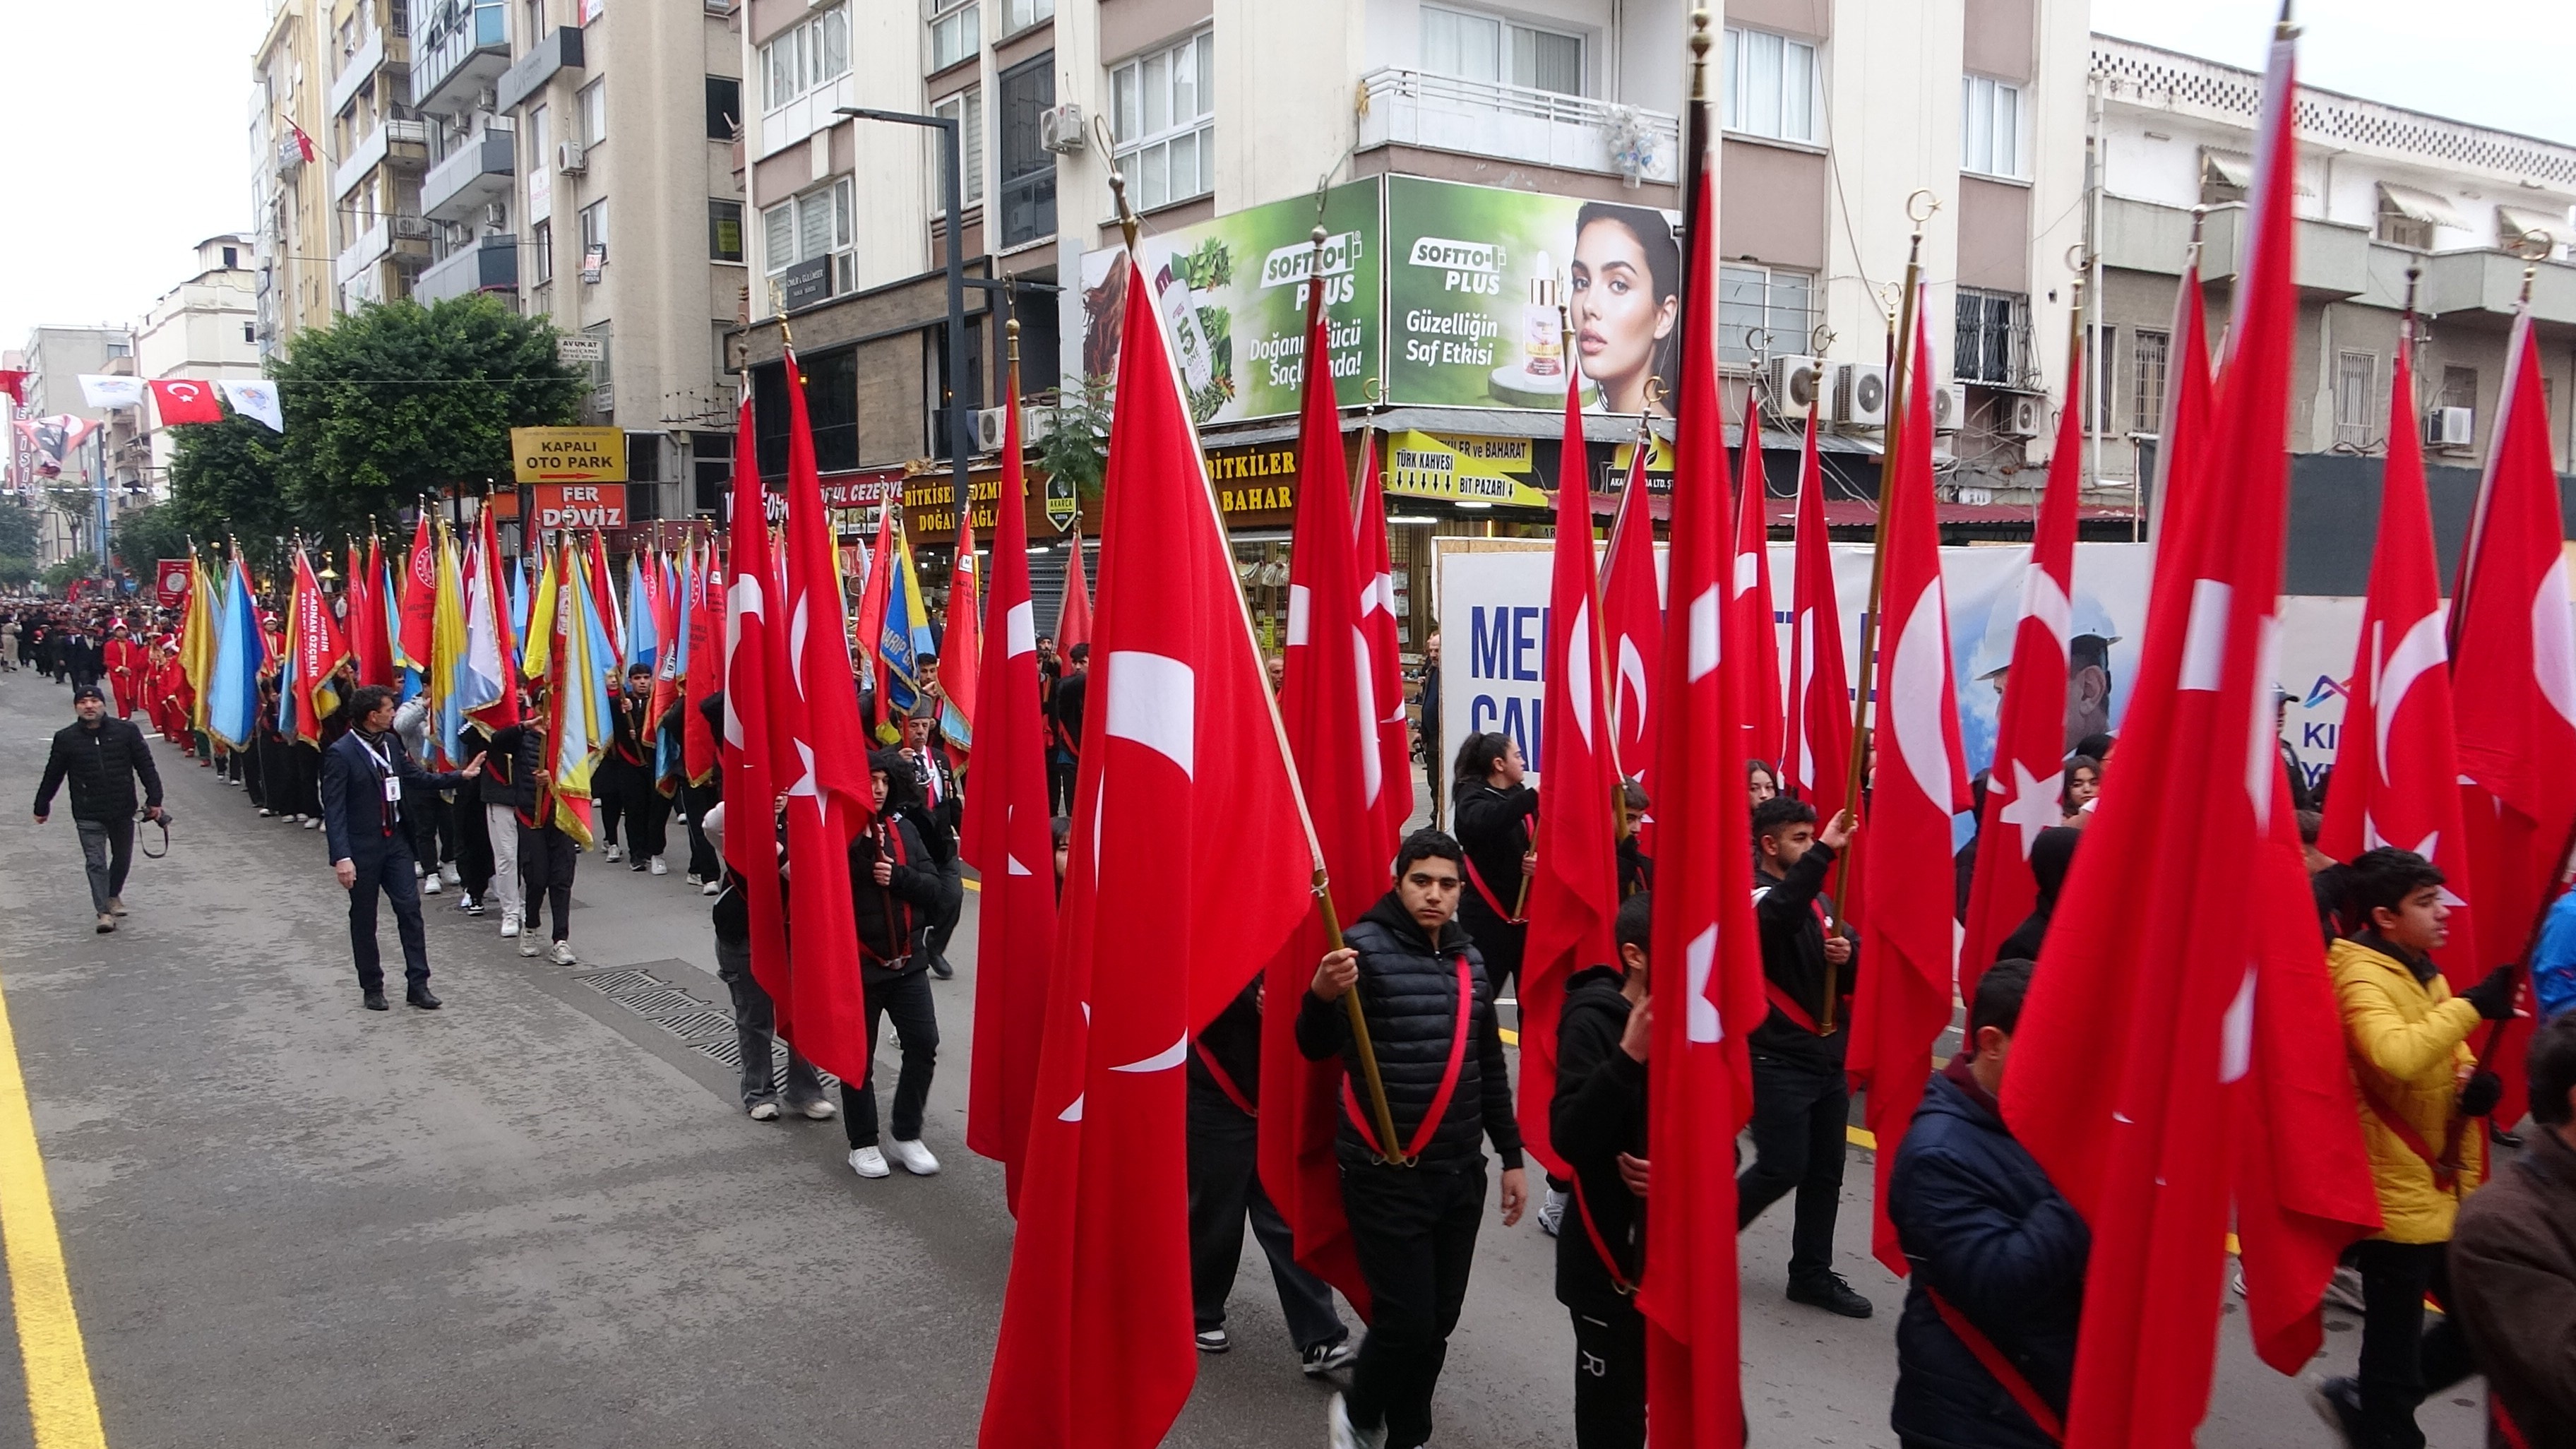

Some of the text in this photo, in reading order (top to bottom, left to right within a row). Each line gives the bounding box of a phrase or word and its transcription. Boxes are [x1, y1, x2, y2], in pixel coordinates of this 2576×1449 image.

[1268, 246, 1337, 281] SOFTO
[1417, 244, 1484, 267] SOFTTO
[1295, 274, 1355, 311] PUS
[1445, 270, 1501, 296] PLUS
[1406, 309, 1498, 342] Güzelliğin
[1249, 331, 1305, 364] Doğanı
[1406, 339, 1441, 367] Saf
[1442, 342, 1494, 366] Etkisi
[541, 441, 597, 453] KAPALI
[1473, 445, 1483, 458] ve
[1485, 441, 1527, 459] BAHARAT
[526, 456, 614, 469] OTO PARK
[1206, 447, 1296, 480] BİTKİLER
[1396, 449, 1454, 471] TÜRK KAHVESİ
[562, 486, 600, 502] FER
[1459, 477, 1505, 497] BİT PAZARI
[542, 504, 621, 527] DÖVİZ
